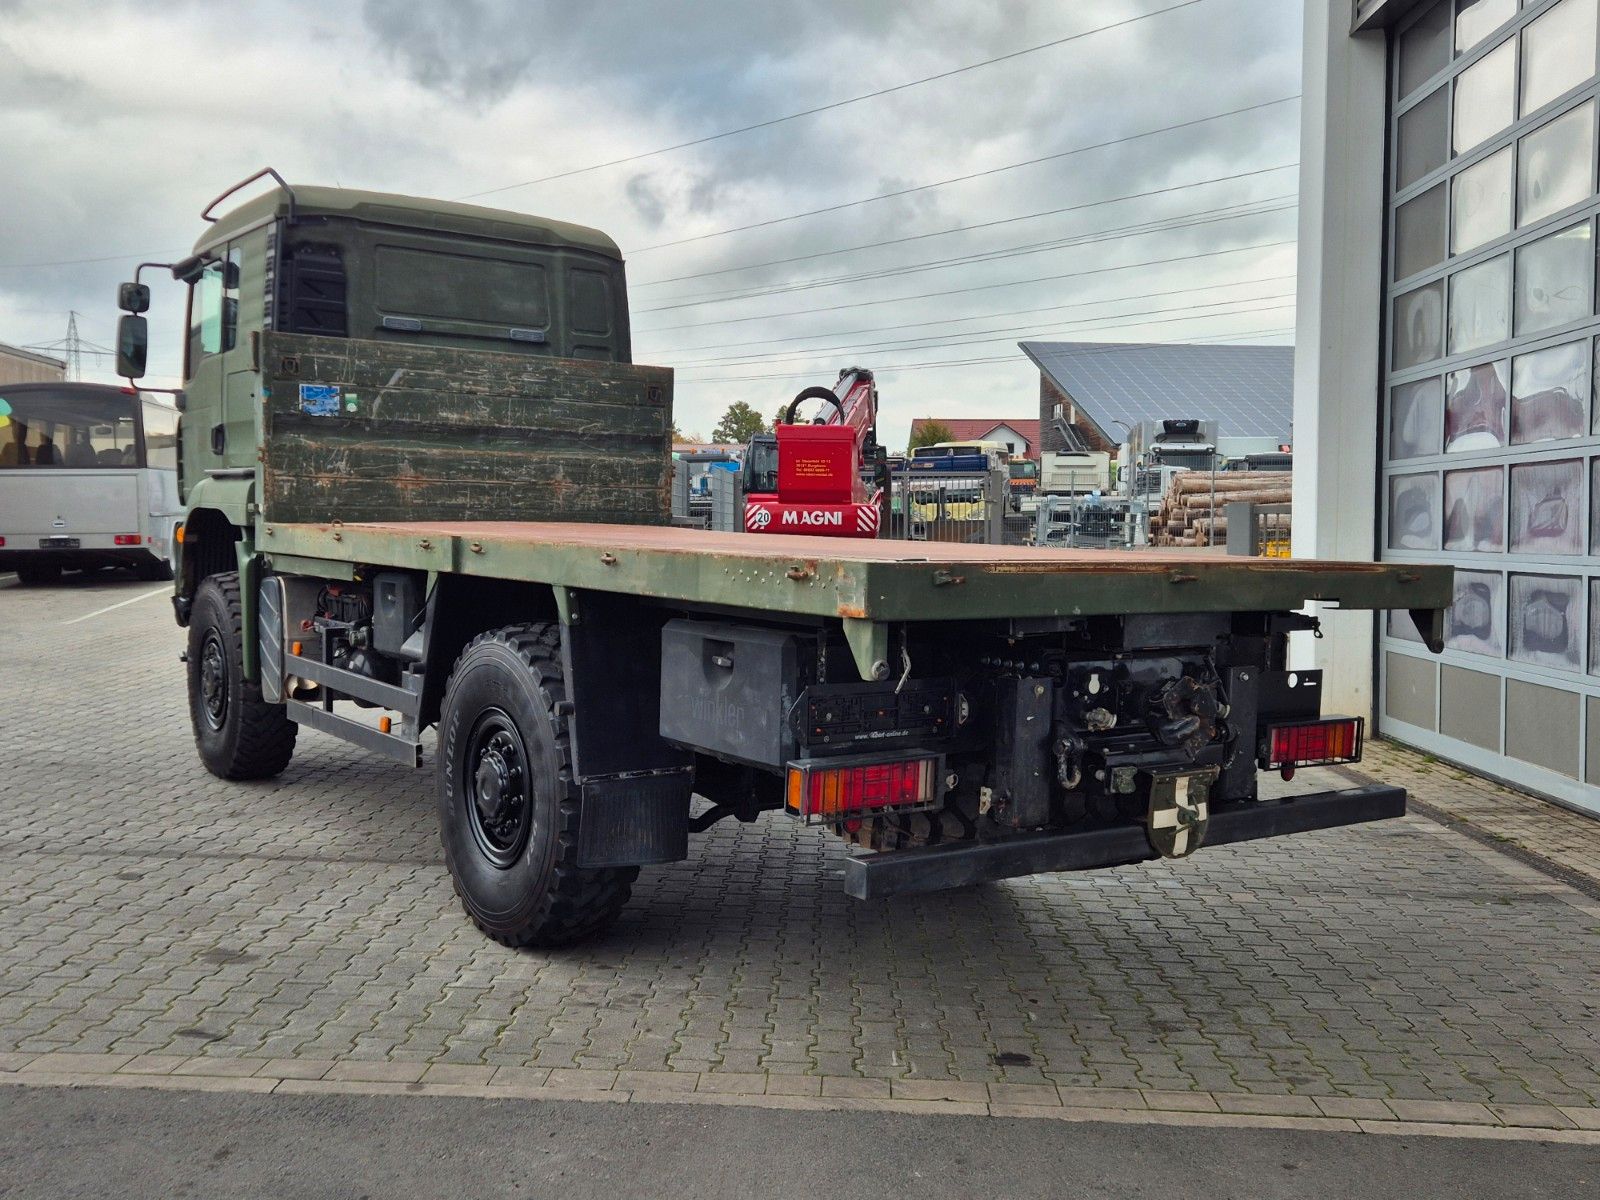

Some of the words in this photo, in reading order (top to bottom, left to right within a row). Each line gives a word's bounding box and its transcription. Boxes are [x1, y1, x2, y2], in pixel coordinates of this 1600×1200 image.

[757, 512, 770, 523] 20
[781, 510, 843, 525] MAGNI
[447, 709, 461, 816] DUNLOP
